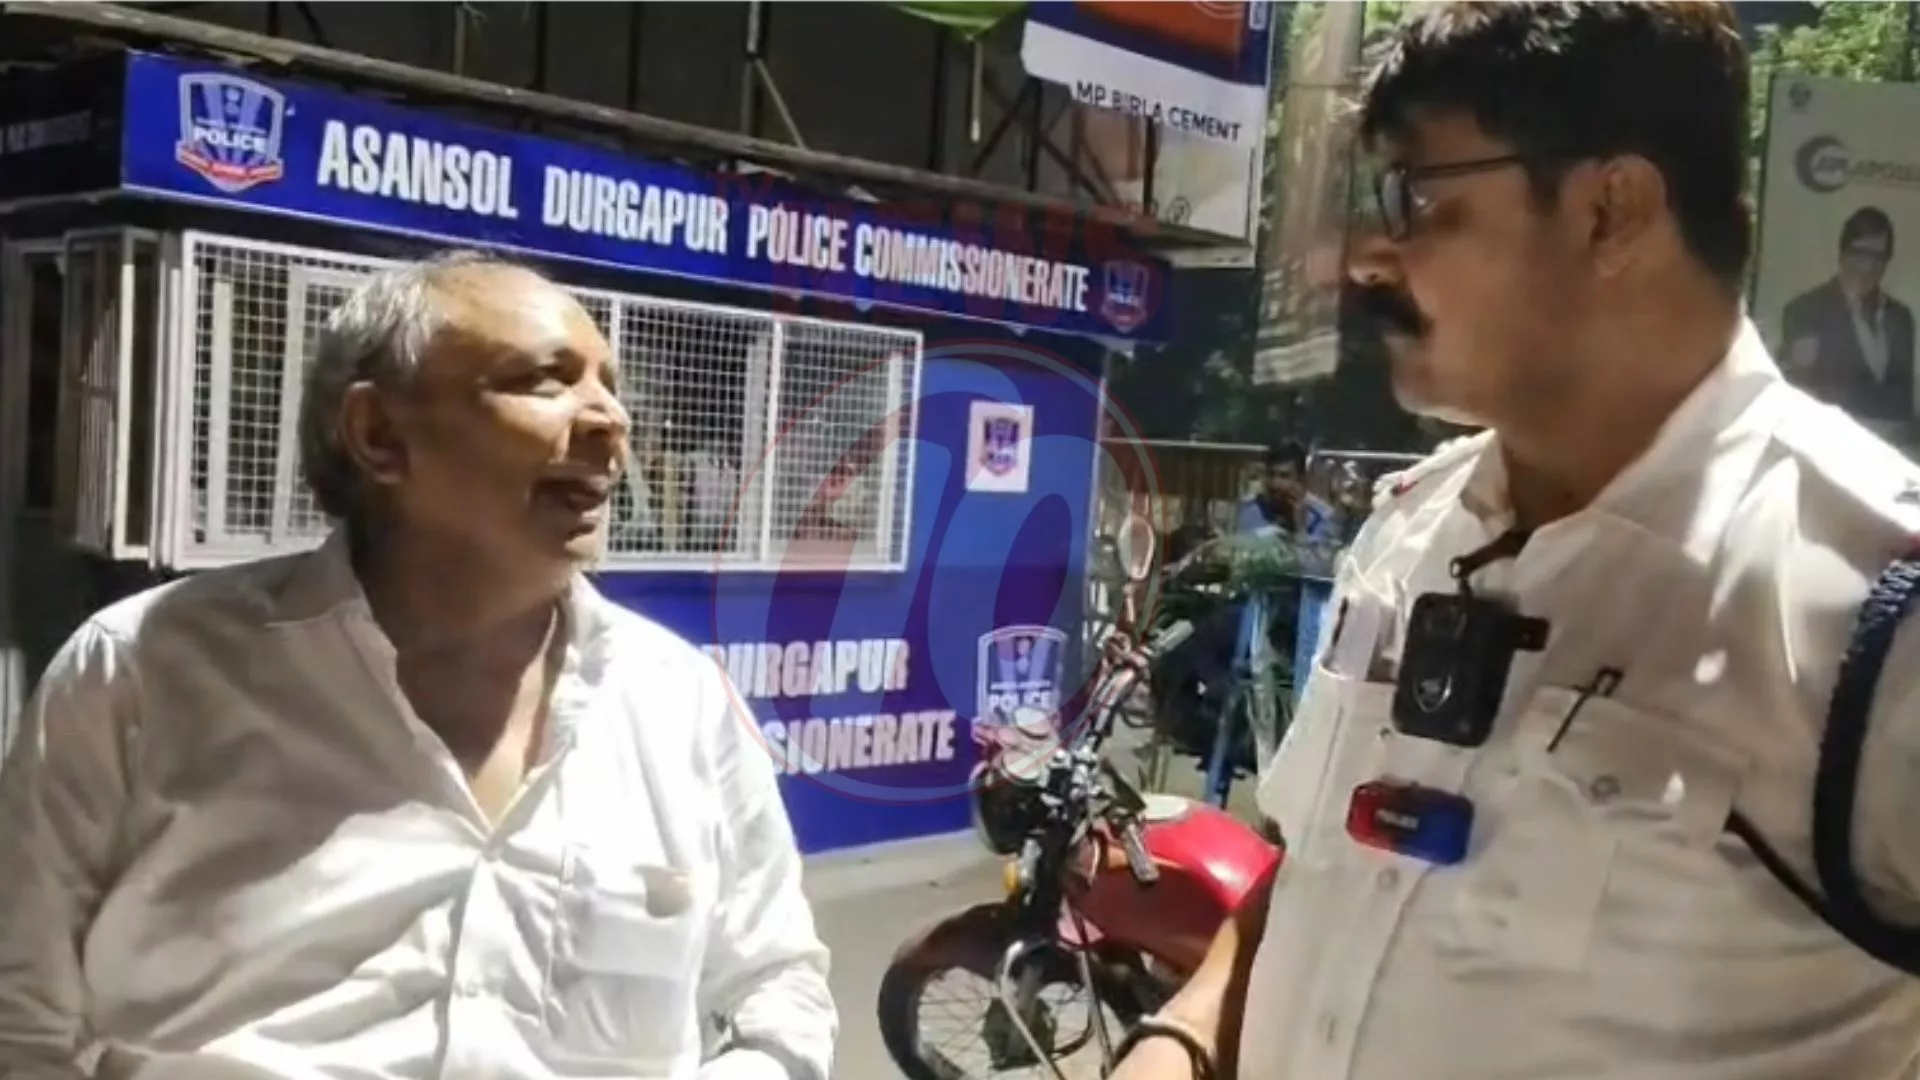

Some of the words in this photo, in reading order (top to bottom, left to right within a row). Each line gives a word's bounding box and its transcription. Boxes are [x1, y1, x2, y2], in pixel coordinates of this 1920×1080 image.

[1076, 80, 1106, 106] MP
[1111, 89, 1164, 123] BIRLA
[1168, 106, 1242, 142] CEMENT
[193, 126, 267, 154] POLICE
[317, 119, 519, 220] ASANSOL
[542, 165, 730, 254] DURGAPUR
[747, 205, 848, 271] POLICE
[853, 222, 1089, 312] COMMISSIONERATE
[988, 691, 1051, 712] POLICE
